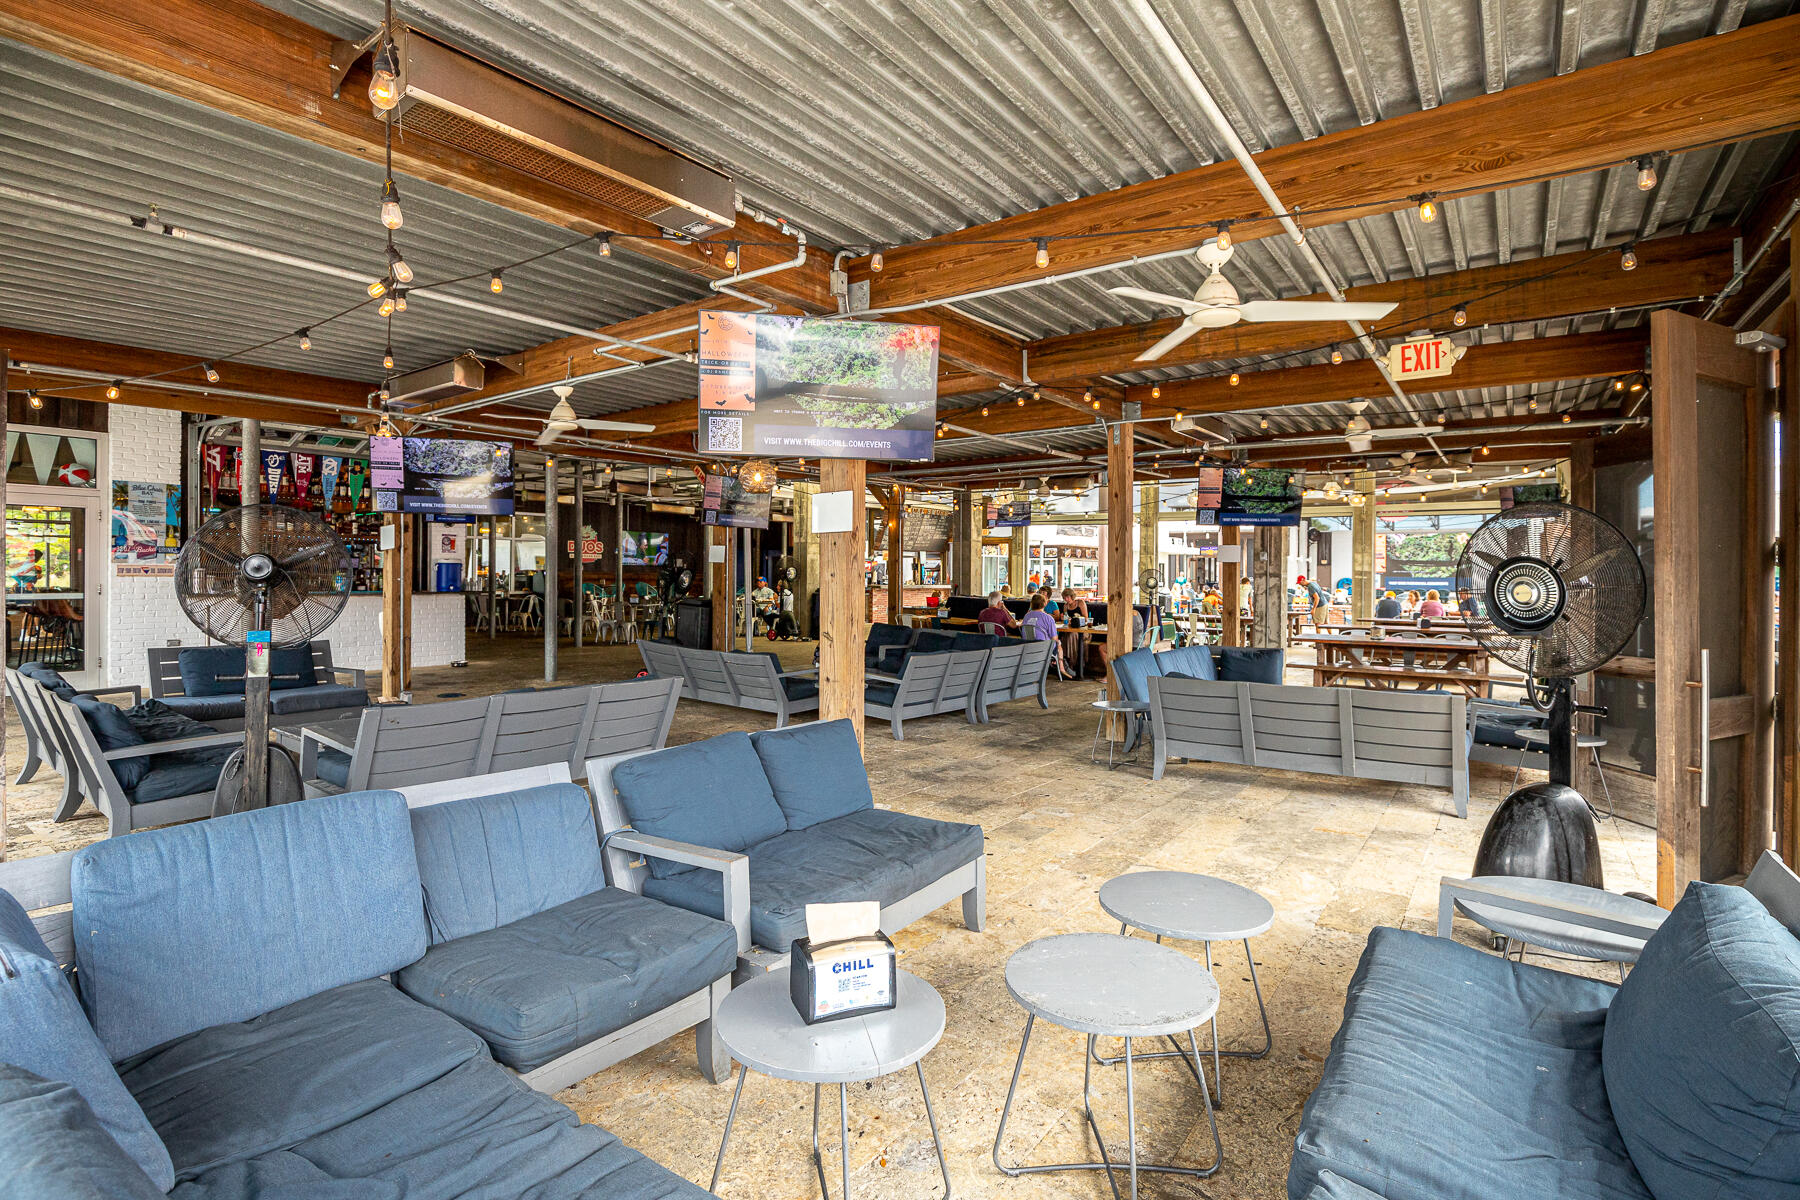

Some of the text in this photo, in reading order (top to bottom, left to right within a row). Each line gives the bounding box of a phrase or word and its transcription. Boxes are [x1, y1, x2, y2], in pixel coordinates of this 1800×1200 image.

[1401, 340, 1443, 373] EXIT
[764, 437, 892, 449] VISIT WWW.THEBIGCHILL.COM/EVENTS
[267, 468, 282, 494] DUKE
[832, 958, 874, 974] CHILL
